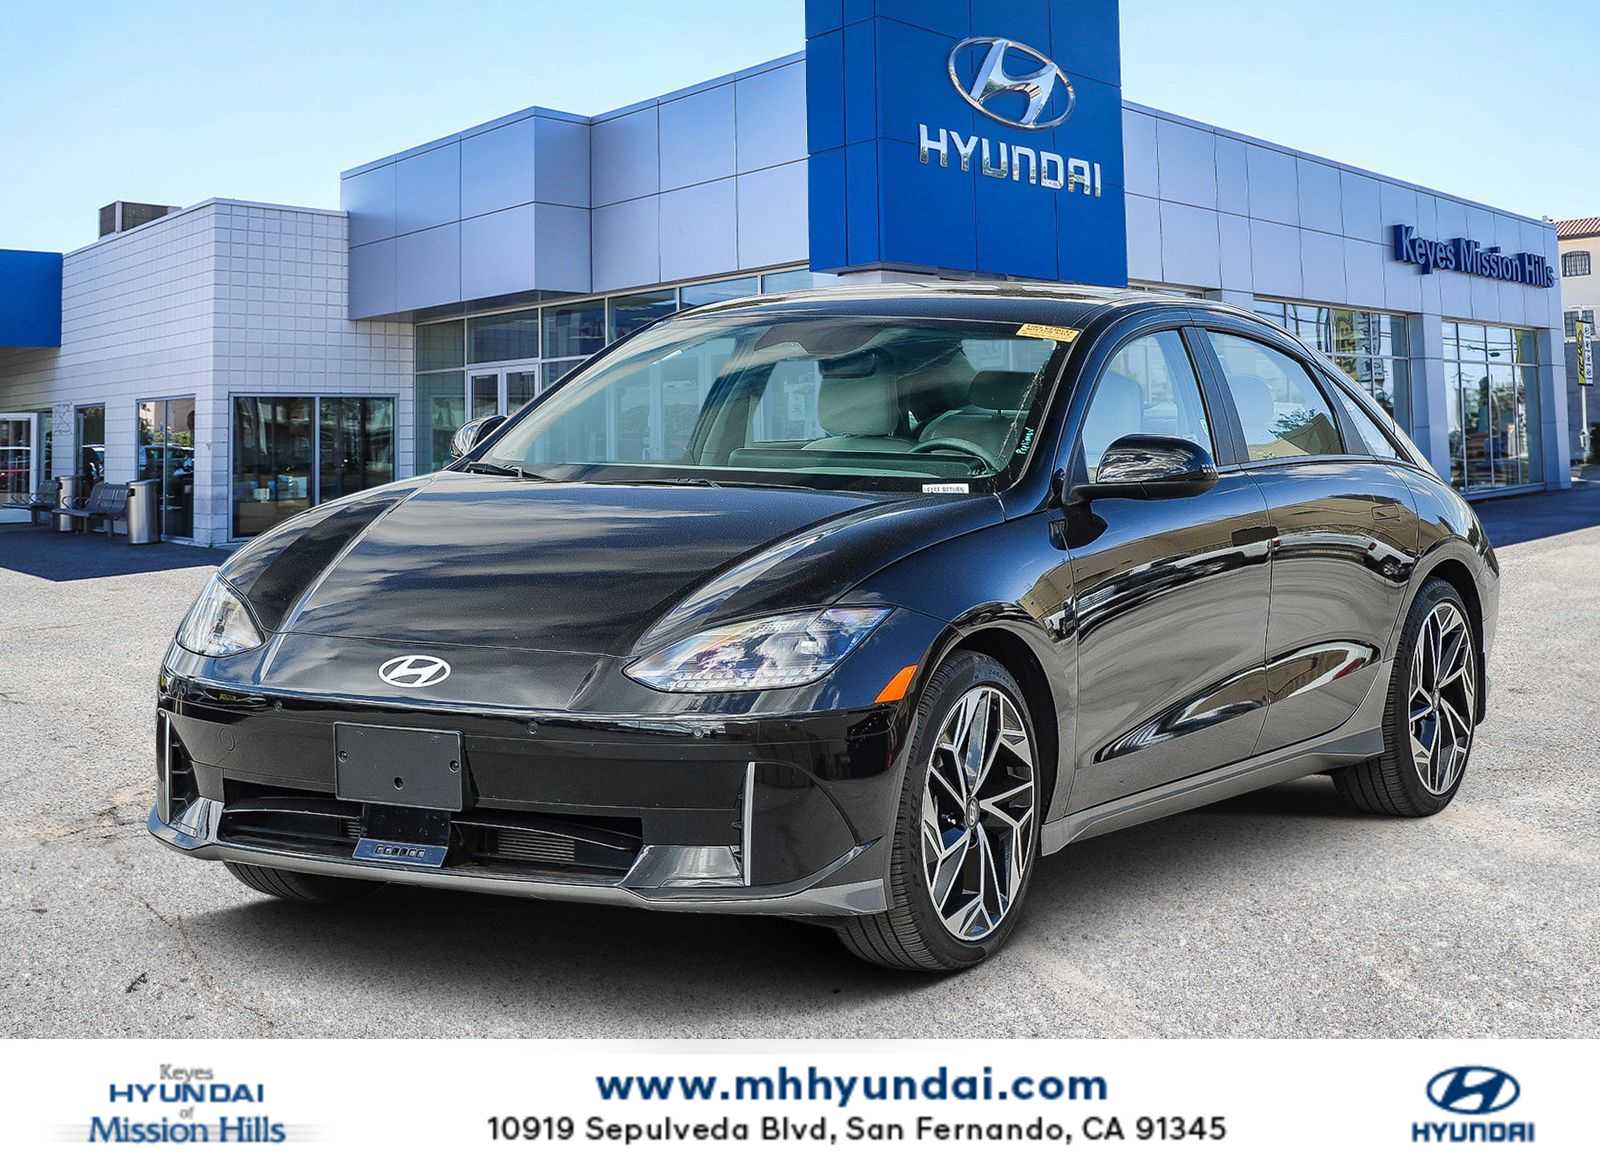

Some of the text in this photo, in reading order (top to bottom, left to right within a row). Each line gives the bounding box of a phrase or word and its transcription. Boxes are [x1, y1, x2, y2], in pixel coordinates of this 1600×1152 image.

[919, 123, 1102, 197] HYUNDAI
[1394, 224, 1555, 288] Keyes Mission Hills
